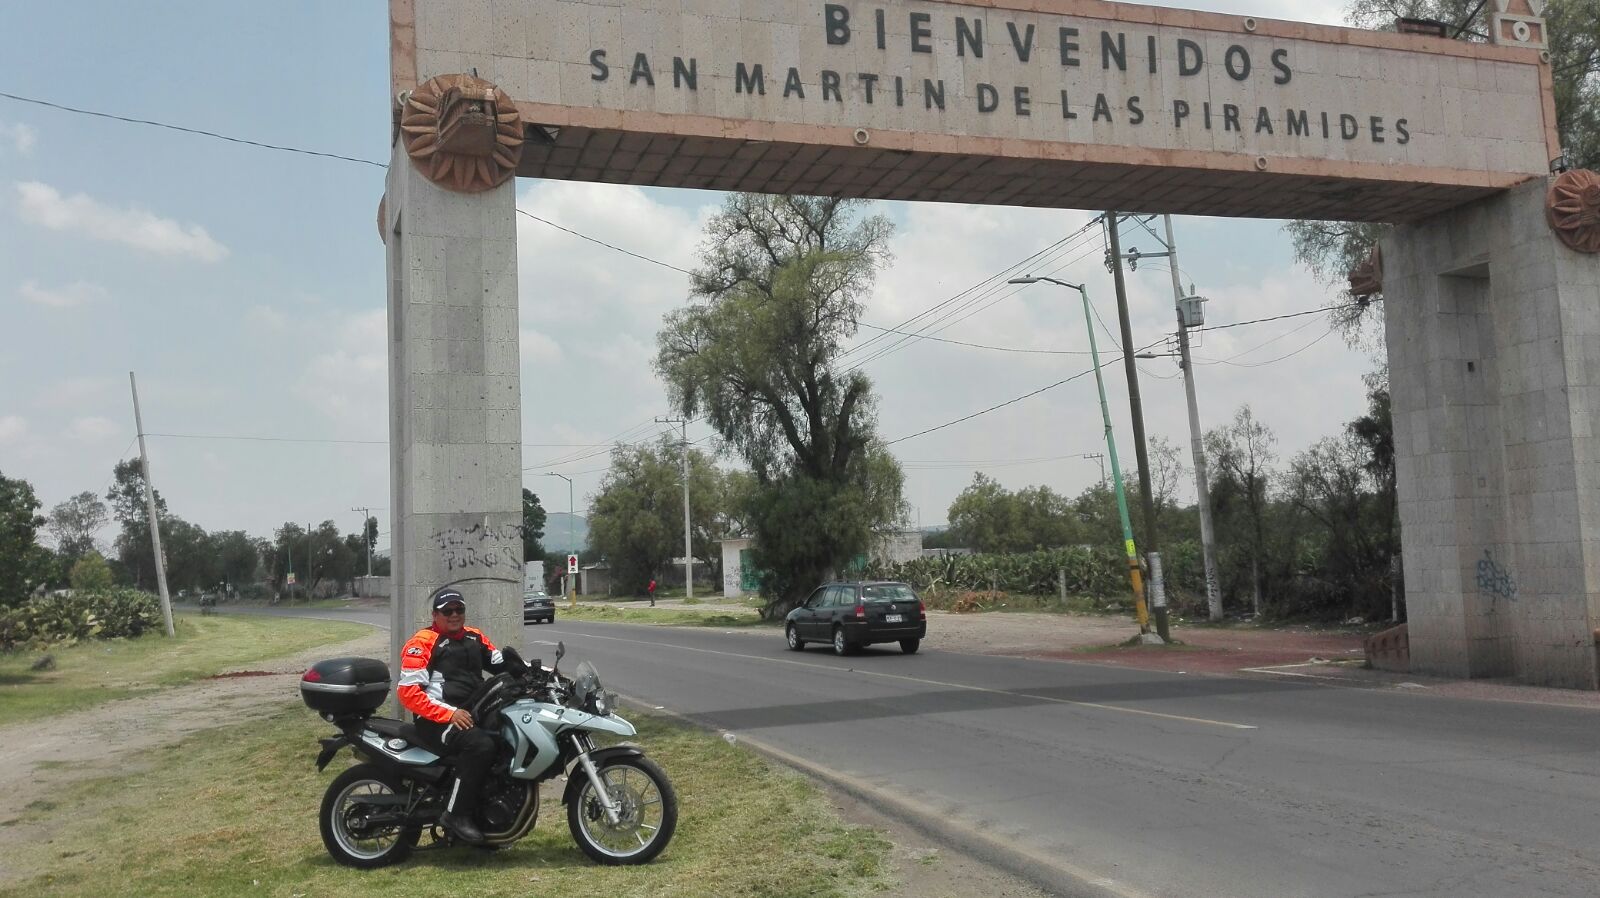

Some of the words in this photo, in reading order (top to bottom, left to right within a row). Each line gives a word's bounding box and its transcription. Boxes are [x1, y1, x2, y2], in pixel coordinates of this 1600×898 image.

[825, 4, 1292, 85] BIENVENIDOS
[590, 49, 698, 90] SAN
[735, 62, 946, 110] MARTIN
[977, 83, 1031, 116] DE
[1061, 89, 1144, 125] LAS
[1174, 99, 1410, 144] PIRAMIDES
